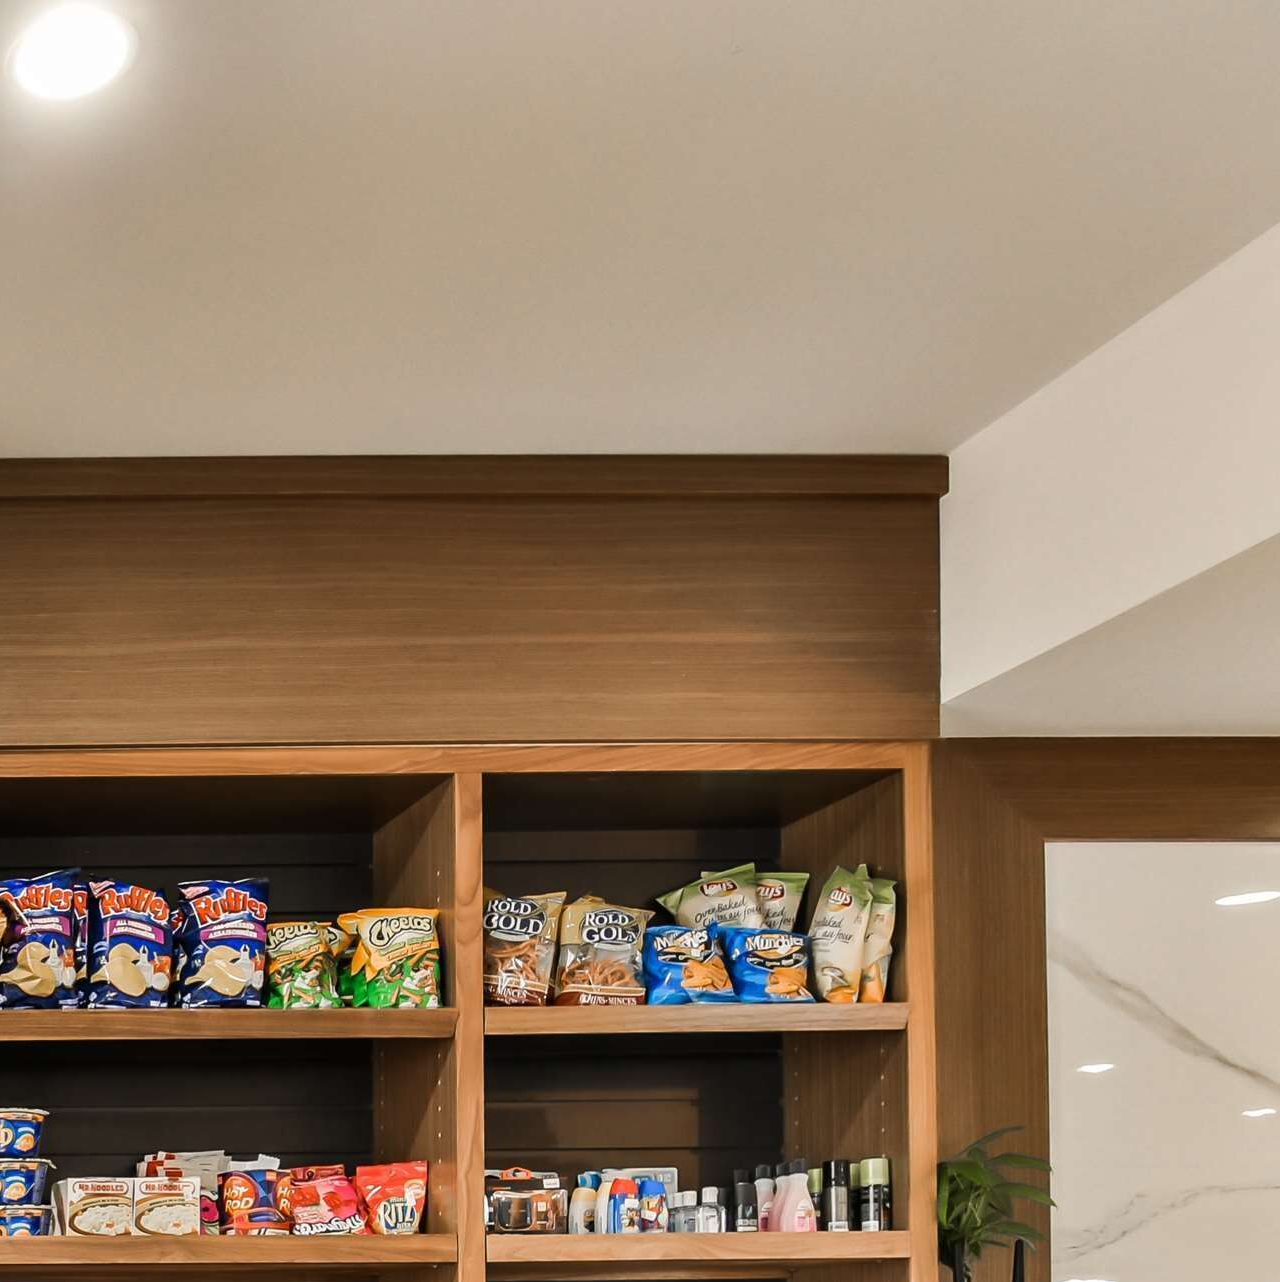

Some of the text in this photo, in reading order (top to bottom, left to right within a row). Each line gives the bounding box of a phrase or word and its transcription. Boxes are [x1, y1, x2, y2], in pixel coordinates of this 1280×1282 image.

[99, 885, 171, 922] Ruffles
[191, 887, 268, 927] Ruffles
[488, 898, 533, 915] ROLD
[484, 911, 543, 934] GOLD
[585, 911, 630, 927] ROLD
[369, 917, 433, 947] Cheetos
[653, 929, 708, 952] Mhies
[90, 1183, 124, 1192] NOODLES
[157, 1183, 184, 1192] NOODL
[224, 1183, 248, 1199] HOT
[225, 1199, 254, 1214] ROD
[383, 1200, 417, 1224] RITZ
